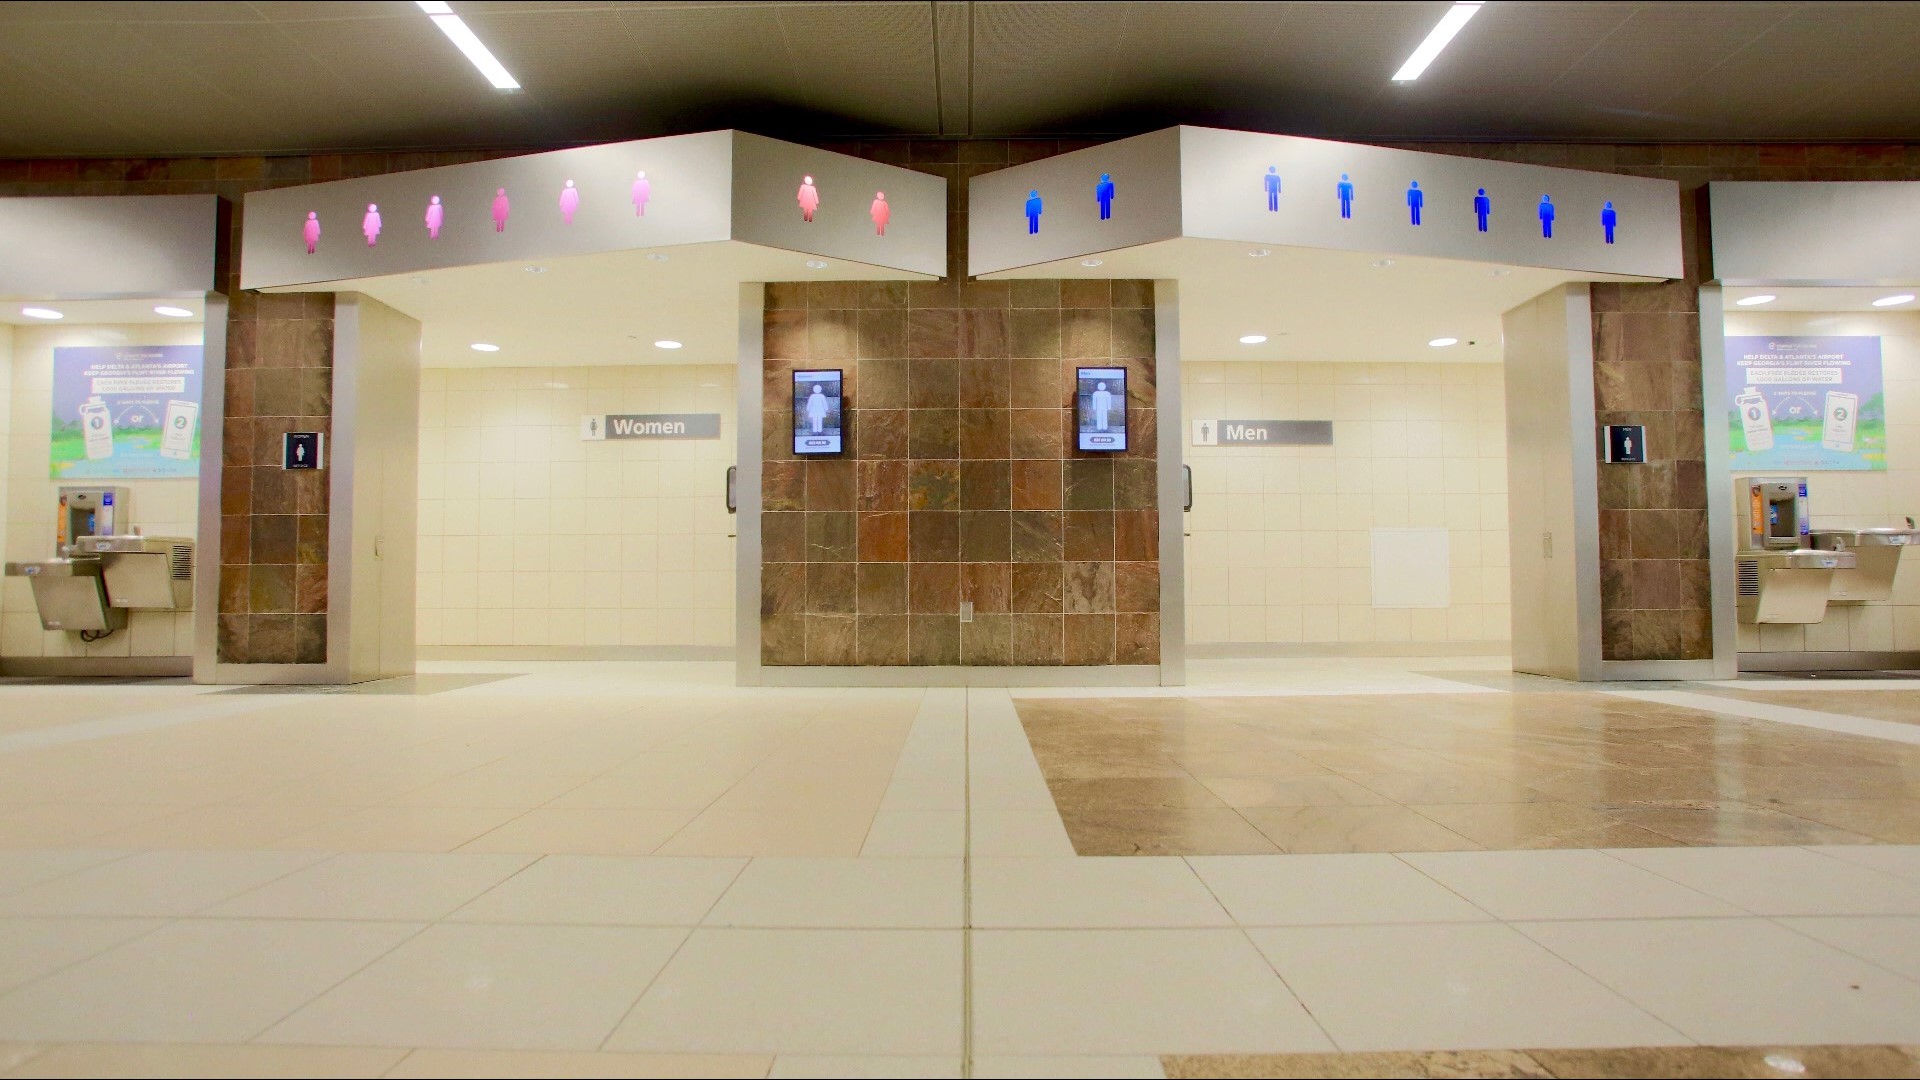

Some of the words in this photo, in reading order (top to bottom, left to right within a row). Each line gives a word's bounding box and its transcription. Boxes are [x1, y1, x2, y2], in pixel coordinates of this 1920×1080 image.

[1788, 406, 1802, 415] or
[613, 419, 685, 434] Women
[1226, 424, 1268, 440] Men
